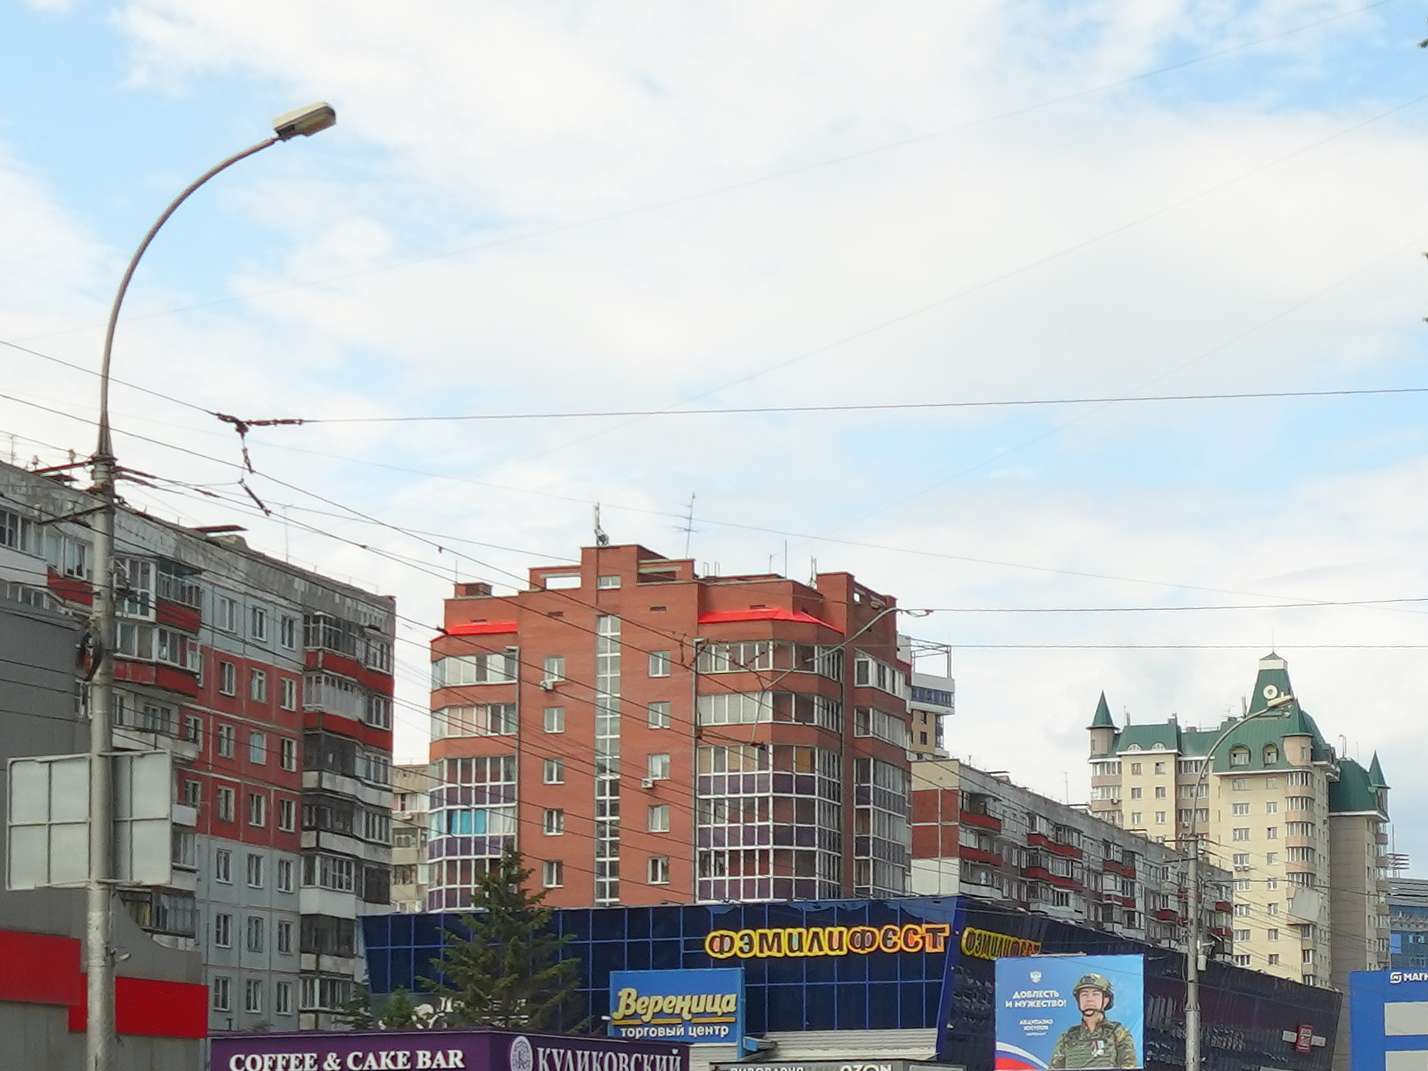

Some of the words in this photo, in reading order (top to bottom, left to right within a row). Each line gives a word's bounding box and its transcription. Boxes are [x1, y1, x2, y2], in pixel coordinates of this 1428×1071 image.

[612, 988, 738, 1022] Вереница
[620, 1025, 685, 1039] торговый
[688, 1026, 729, 1038] центр
[322, 1052, 341, 1071] &
[347, 1050, 411, 1071] CAKE
[416, 1049, 465, 1069] BAR
